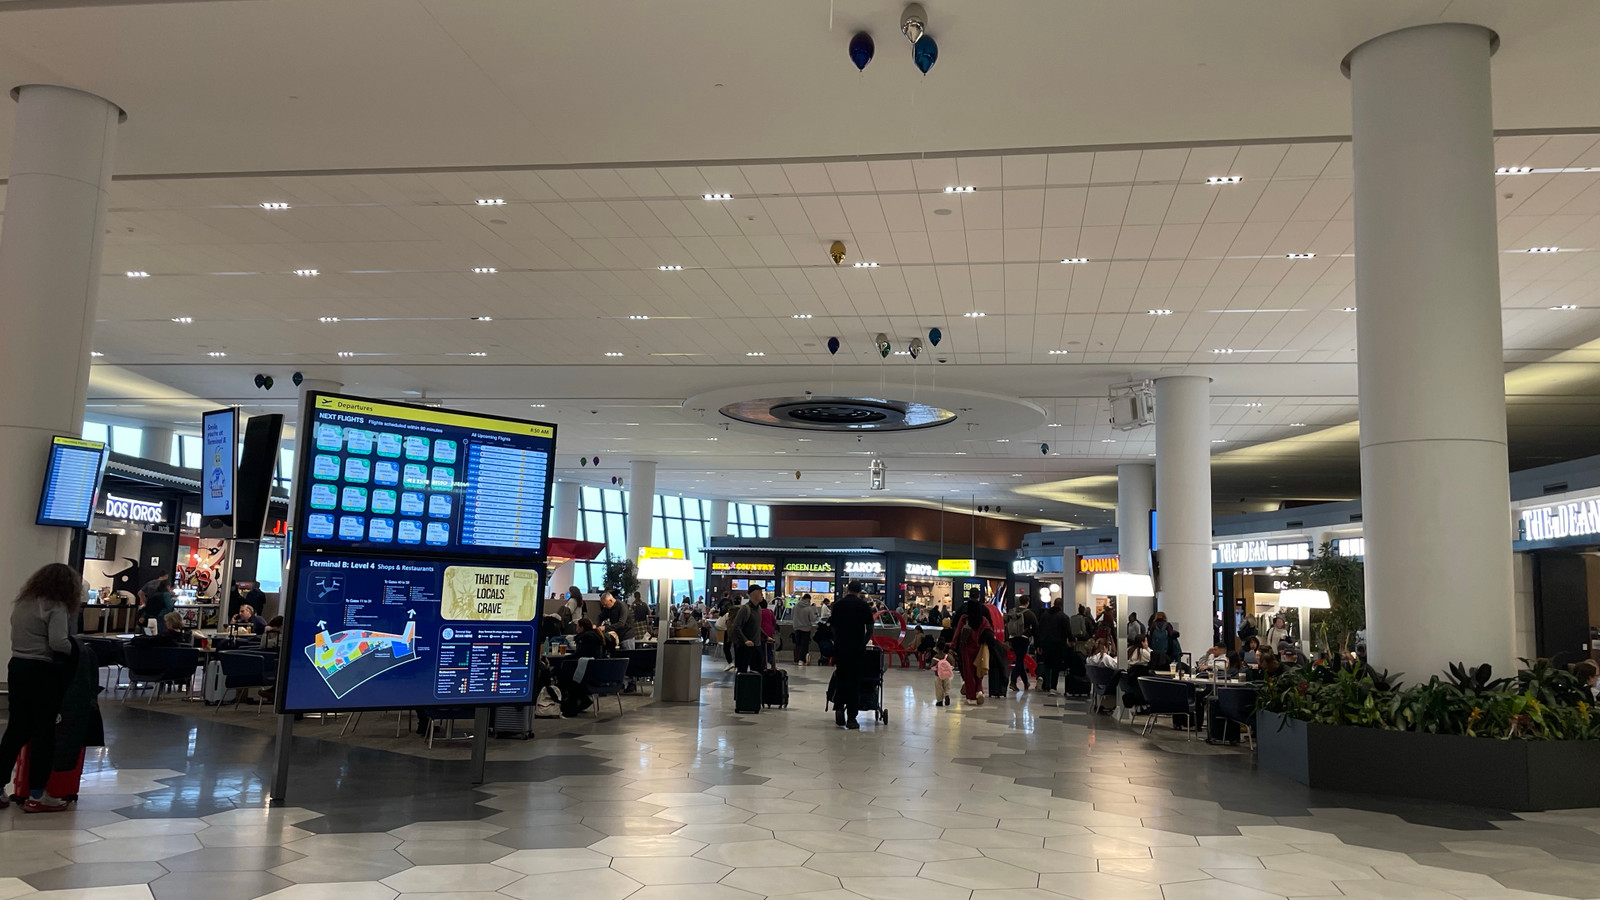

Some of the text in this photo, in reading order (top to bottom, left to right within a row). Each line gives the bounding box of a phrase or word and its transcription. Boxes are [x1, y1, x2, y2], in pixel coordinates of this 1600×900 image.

[337, 401, 374, 412] Departures
[319, 412, 365, 424] NEXT FLIGHTS
[384, 421, 407, 429] scheduled
[477, 433, 498, 441] Upcoming
[106, 499, 162, 523] DOS TOROS
[1522, 499, 1600, 541] THE DEAN
[1218, 540, 1268, 564] THE DEAN
[309, 559, 340, 568] Terminal
[341, 561, 350, 569] B:
[350, 561, 369, 569] Level
[377, 563, 395, 571] Shops
[401, 564, 434, 572] Restaurants
[712, 562, 775, 571] HILL COUNTRY
[785, 563, 809, 571] GREEN
[845, 561, 882, 573] ZARO'S
[475, 573, 510, 586] THAT THE
[476, 588, 506, 600] LOCALS
[477, 602, 503, 614] CRAVE
